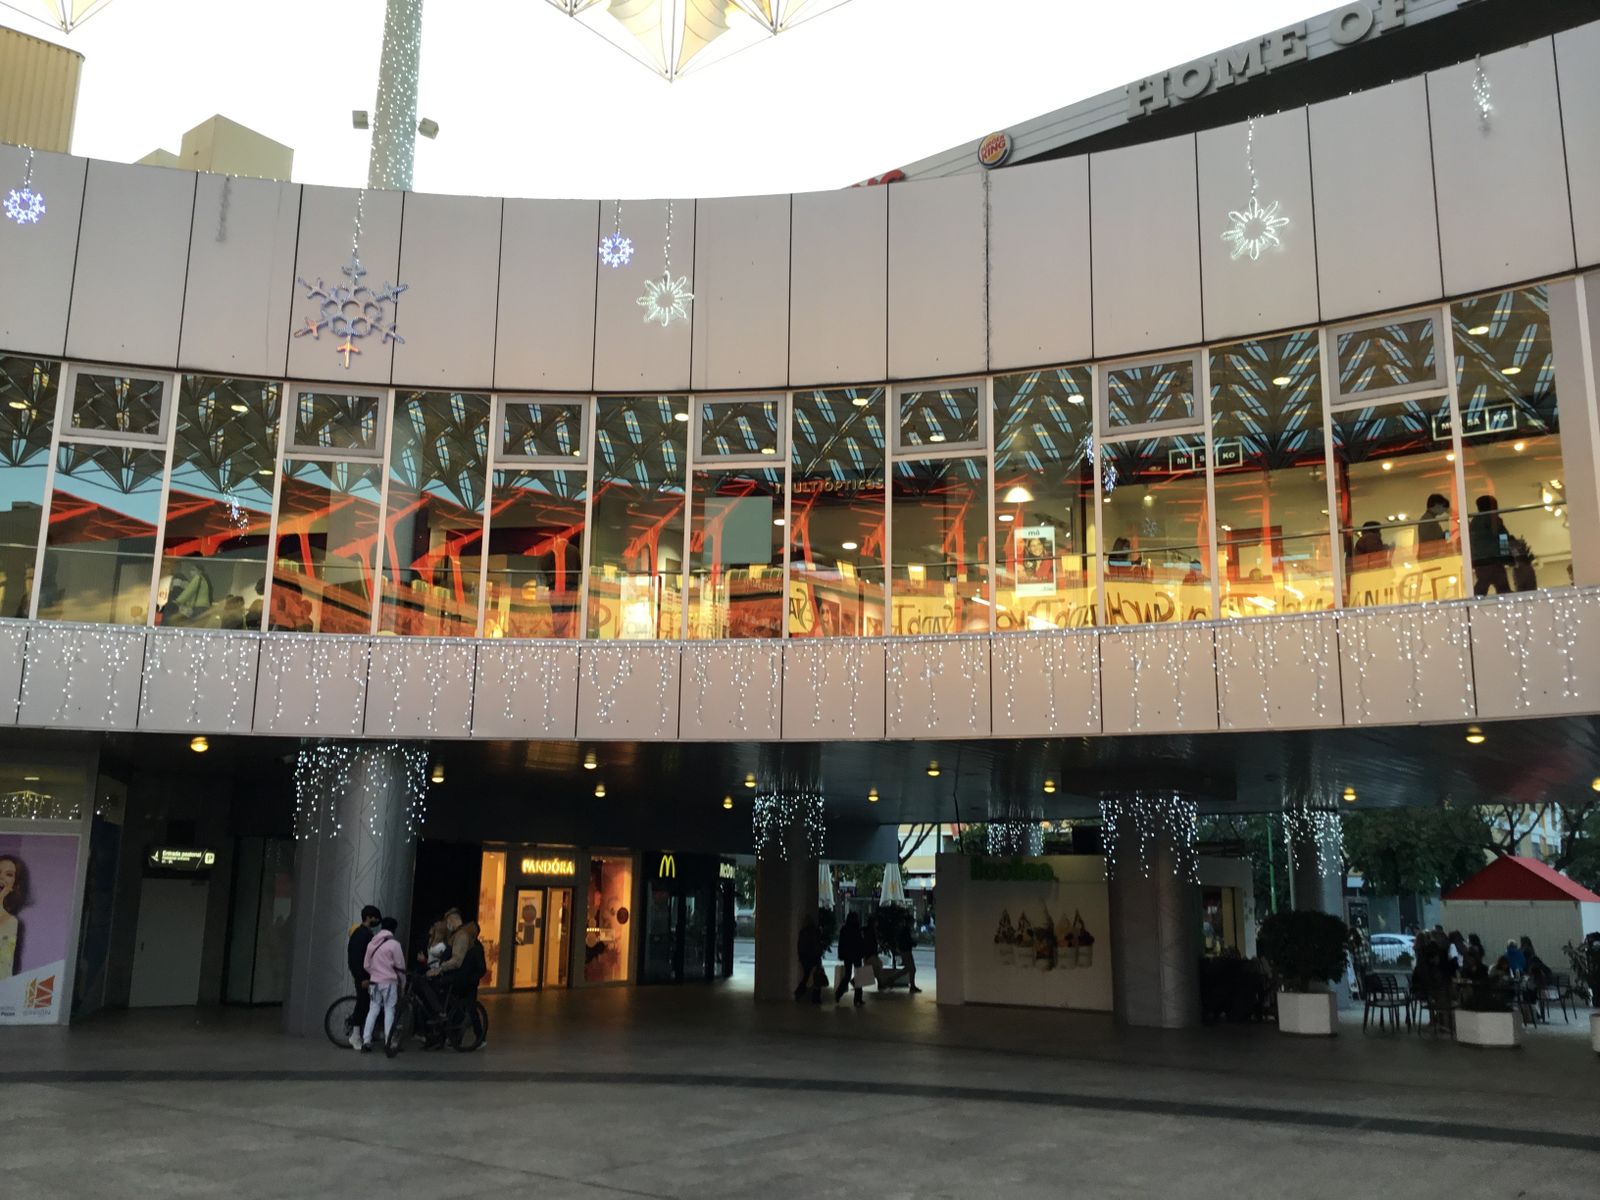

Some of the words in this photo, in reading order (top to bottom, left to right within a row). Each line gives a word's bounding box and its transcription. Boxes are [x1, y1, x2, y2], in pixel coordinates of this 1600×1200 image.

[1127, 20, 1308, 120] HOME
[980, 140, 1006, 161] KING
[1222, 451, 1236, 460] KO
